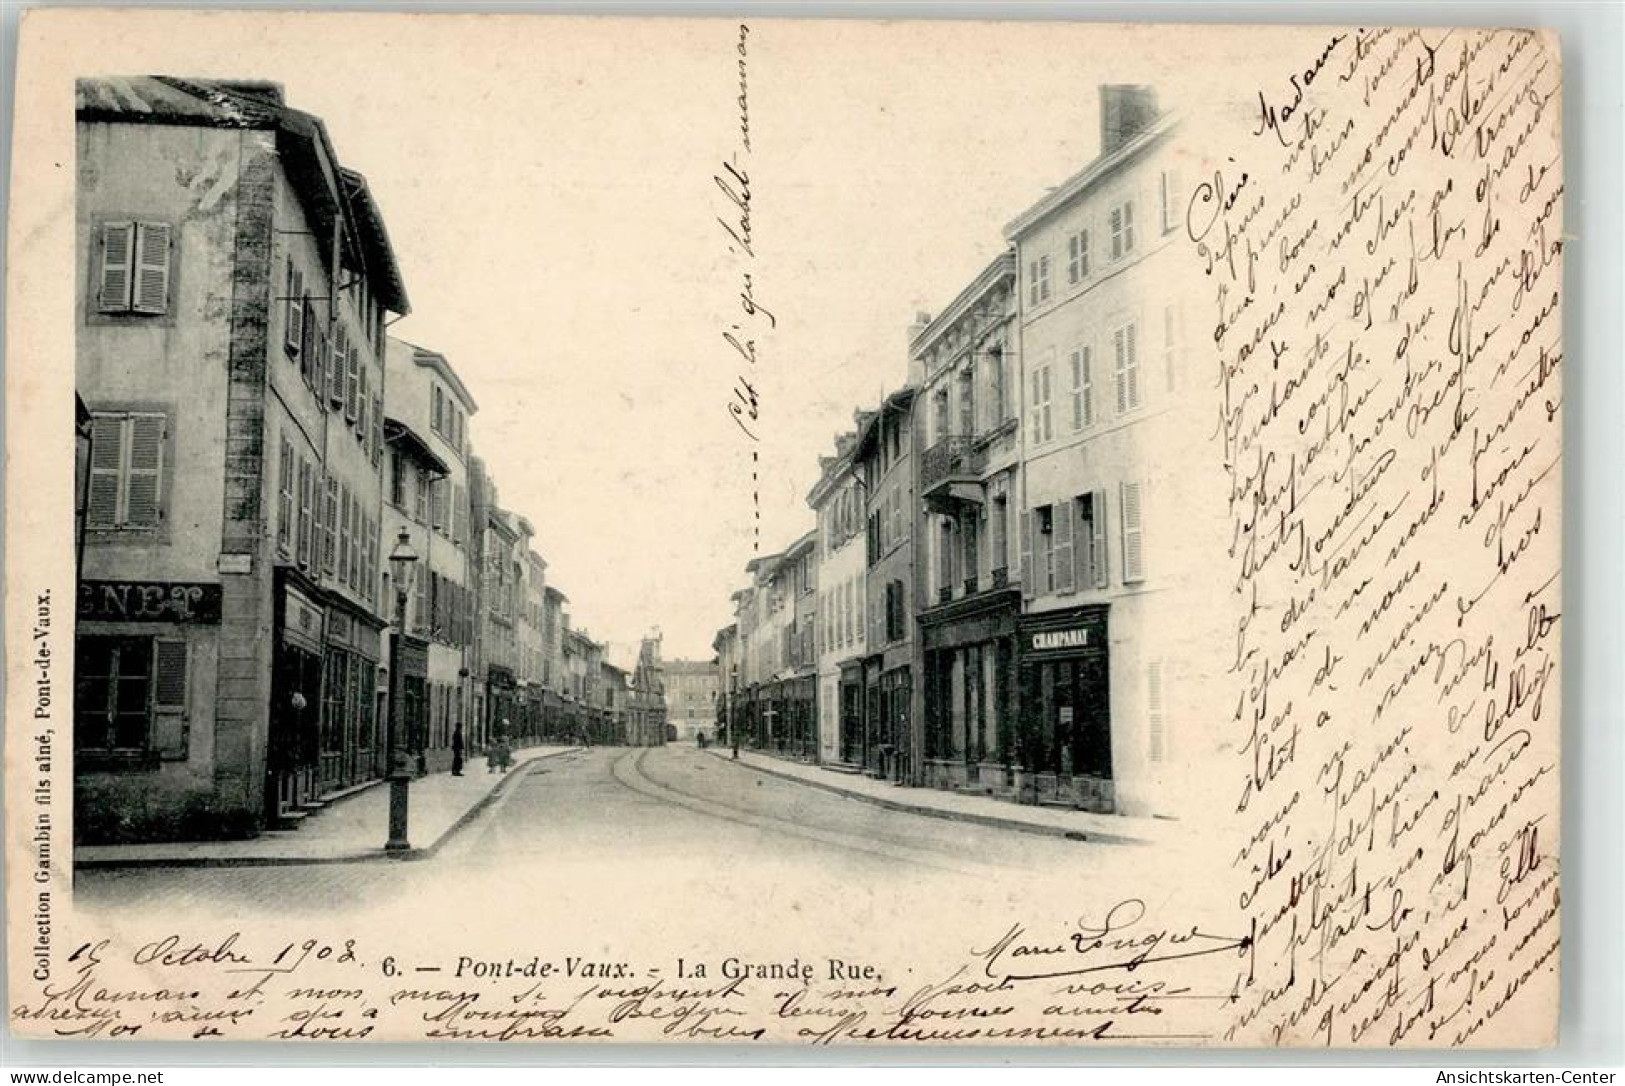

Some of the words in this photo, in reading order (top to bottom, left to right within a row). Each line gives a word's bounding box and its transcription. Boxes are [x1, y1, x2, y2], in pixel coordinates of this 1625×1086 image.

[1281, 219, 1319, 274] bons
[1341, 31, 1451, 193] moments
[1284, 105, 1328, 175] notre
[1308, 117, 1354, 184] bien
[1294, 264, 1317, 295] en
[1327, 159, 1387, 255] votre
[1394, 305, 1433, 383] que
[1520, 153, 1561, 204] de
[1270, 338, 1289, 371] de
[1304, 265, 1345, 329] nos
[1351, 257, 1395, 331] que
[1487, 289, 1558, 390] nous
[1383, 490, 1445, 567] nous
[1484, 451, 1563, 568] que
[33, 587, 51, 719] Pont-de-Vaux.
[1306, 643, 1345, 698] de
[1355, 559, 1421, 642] nous
[33, 778, 51, 805] fils
[33, 813, 51, 884] Gambin
[33, 892, 51, 981] Collection
[134, 931, 252, 966] Octobre
[381, 957, 403, 978] 6.
[455, 956, 637, 978] Pont-de-Vaux.
[677, 957, 707, 978] La
[721, 957, 813, 978] Grande
[43, 966, 200, 1011] Maman
